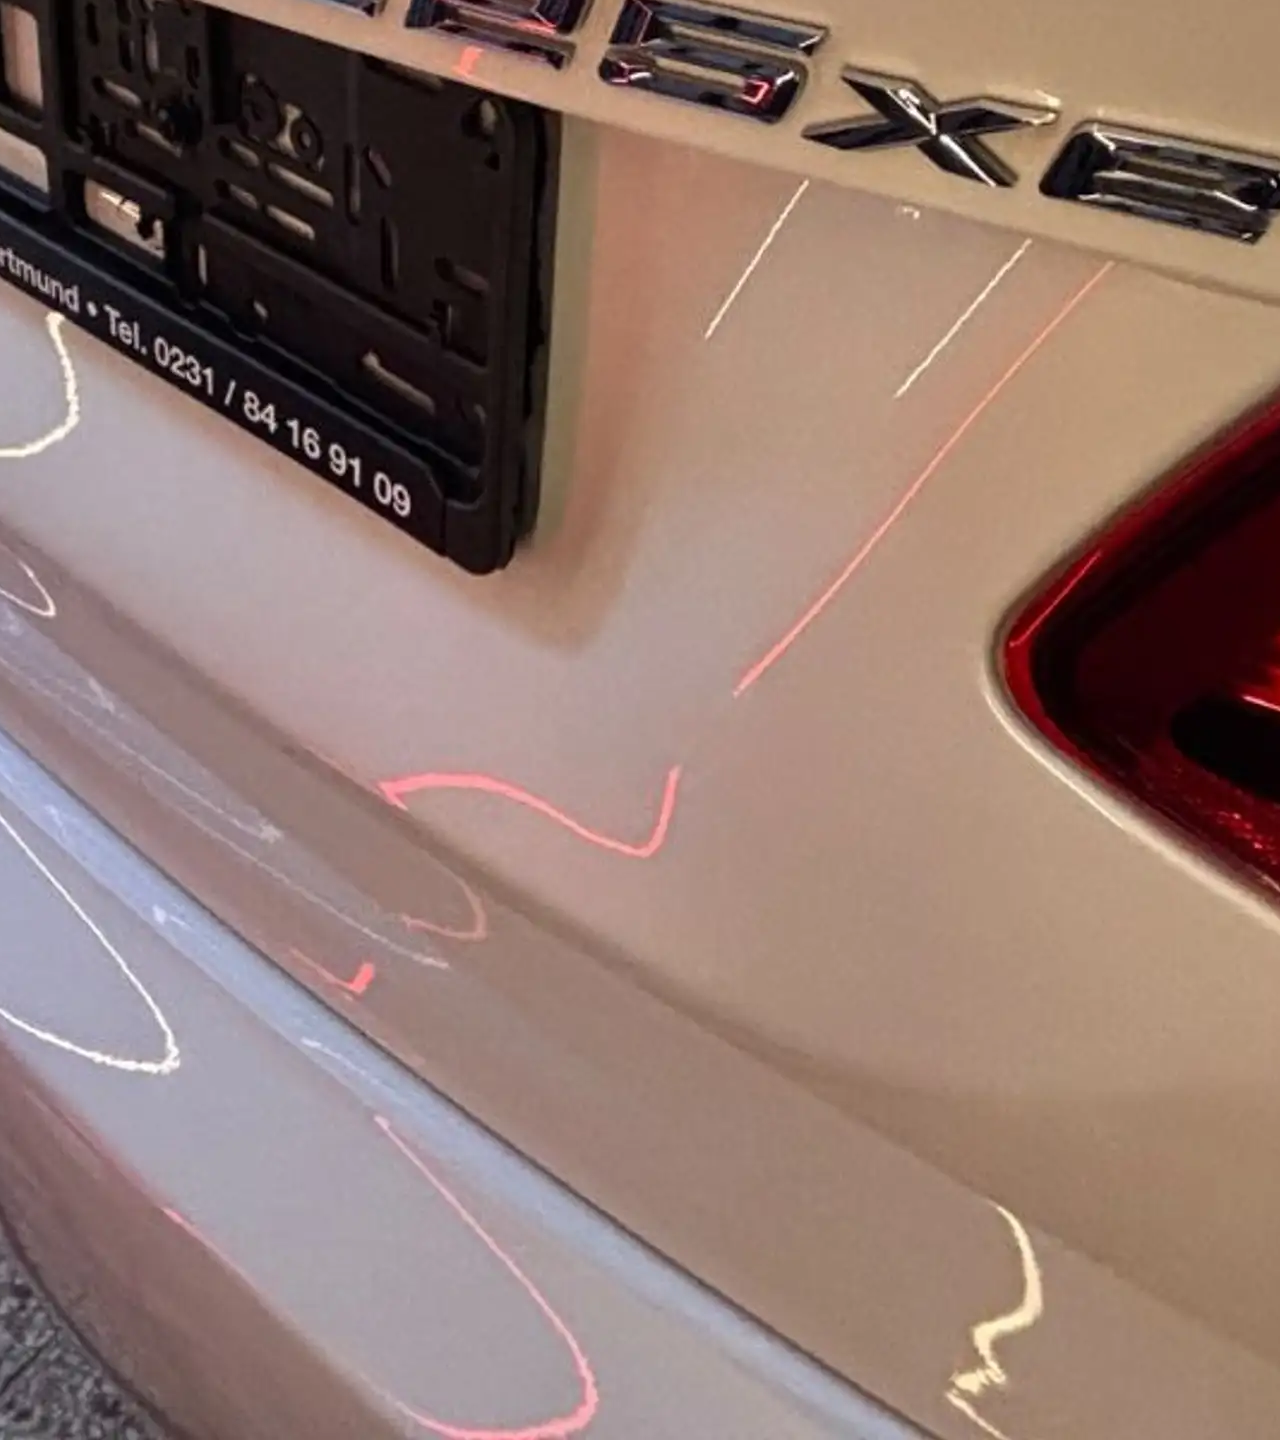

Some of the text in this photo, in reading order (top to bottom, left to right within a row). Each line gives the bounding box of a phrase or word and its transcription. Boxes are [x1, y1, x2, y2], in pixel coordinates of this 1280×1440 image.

[104, 304, 148, 356] Tel.
[154, 336, 215, 396] 0231
[243, 390, 278, 435] 84
[286, 418, 322, 461] 16
[329, 444, 363, 488] 91
[373, 471, 412, 518] 09
